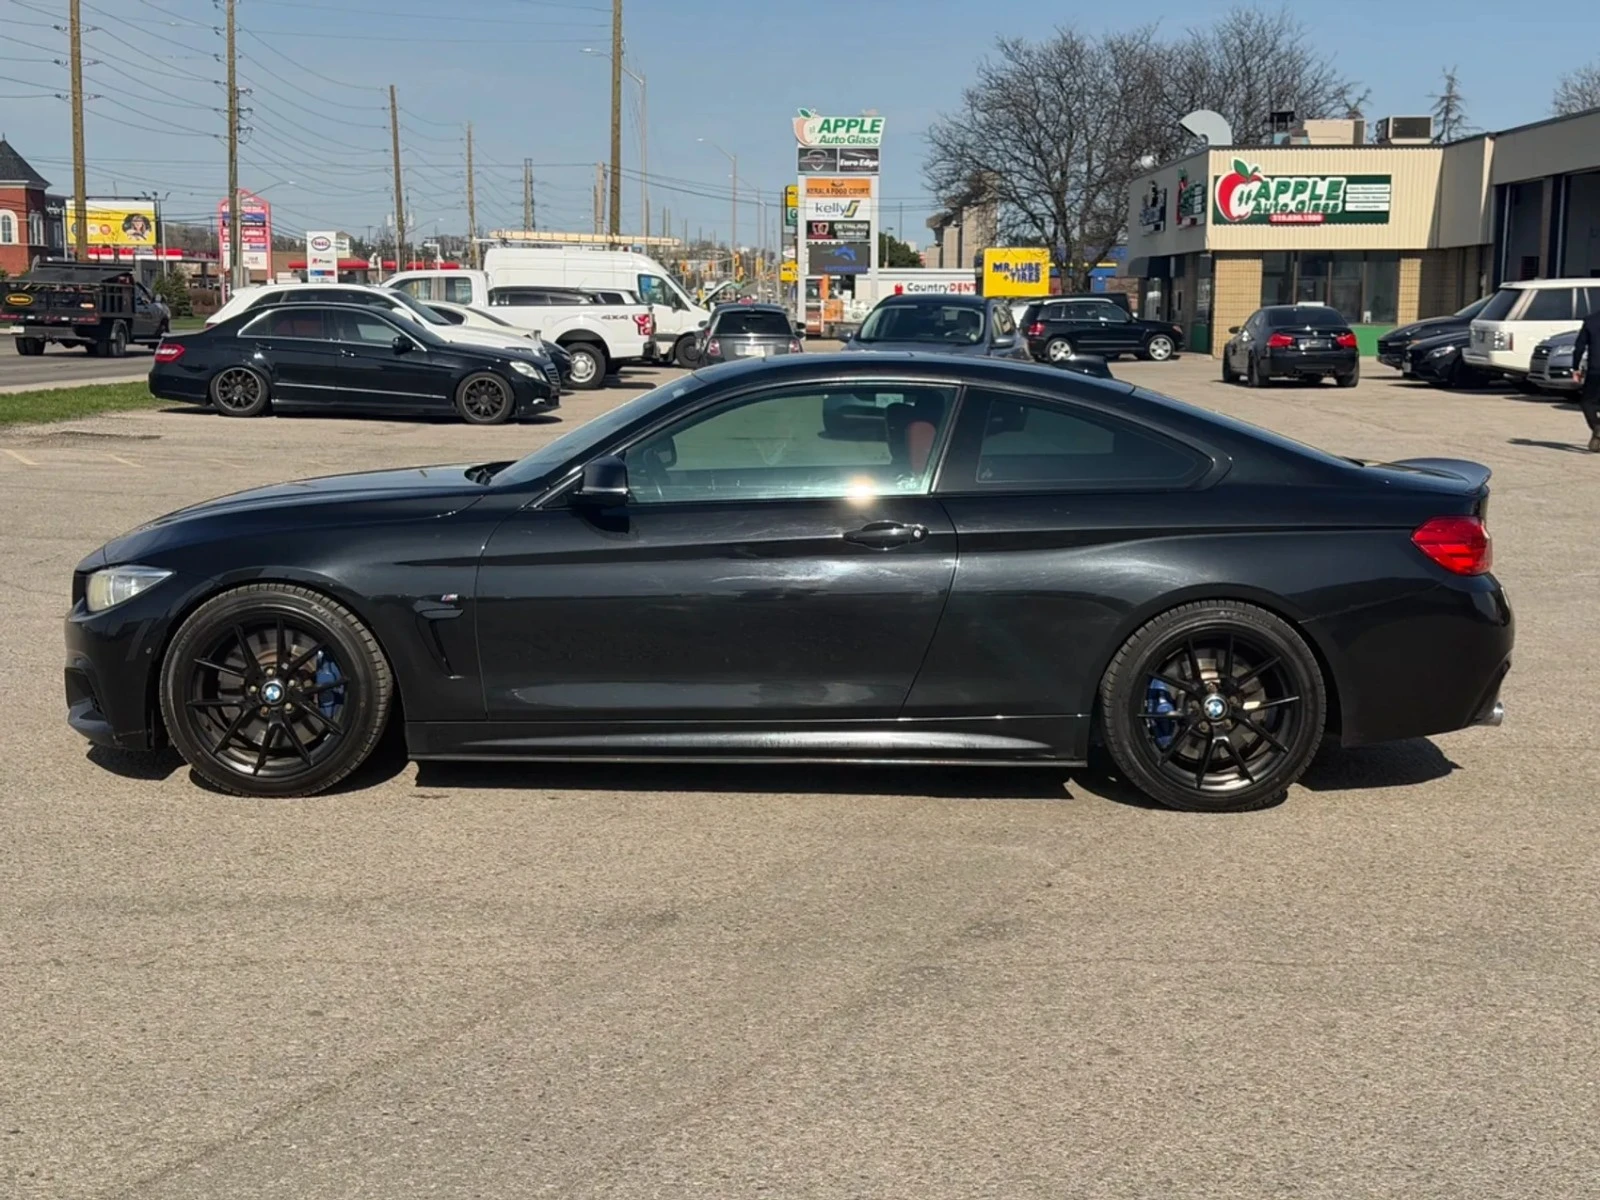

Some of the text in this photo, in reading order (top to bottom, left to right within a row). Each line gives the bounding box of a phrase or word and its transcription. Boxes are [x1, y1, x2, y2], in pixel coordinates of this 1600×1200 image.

[818, 118, 882, 134] APPLE
[819, 135, 879, 144] Auto Glass
[1252, 180, 1345, 201] APPLE
[815, 203, 848, 216] kelly
[1014, 262, 1041, 272] LUBE
[1010, 271, 1041, 283] TIRES
